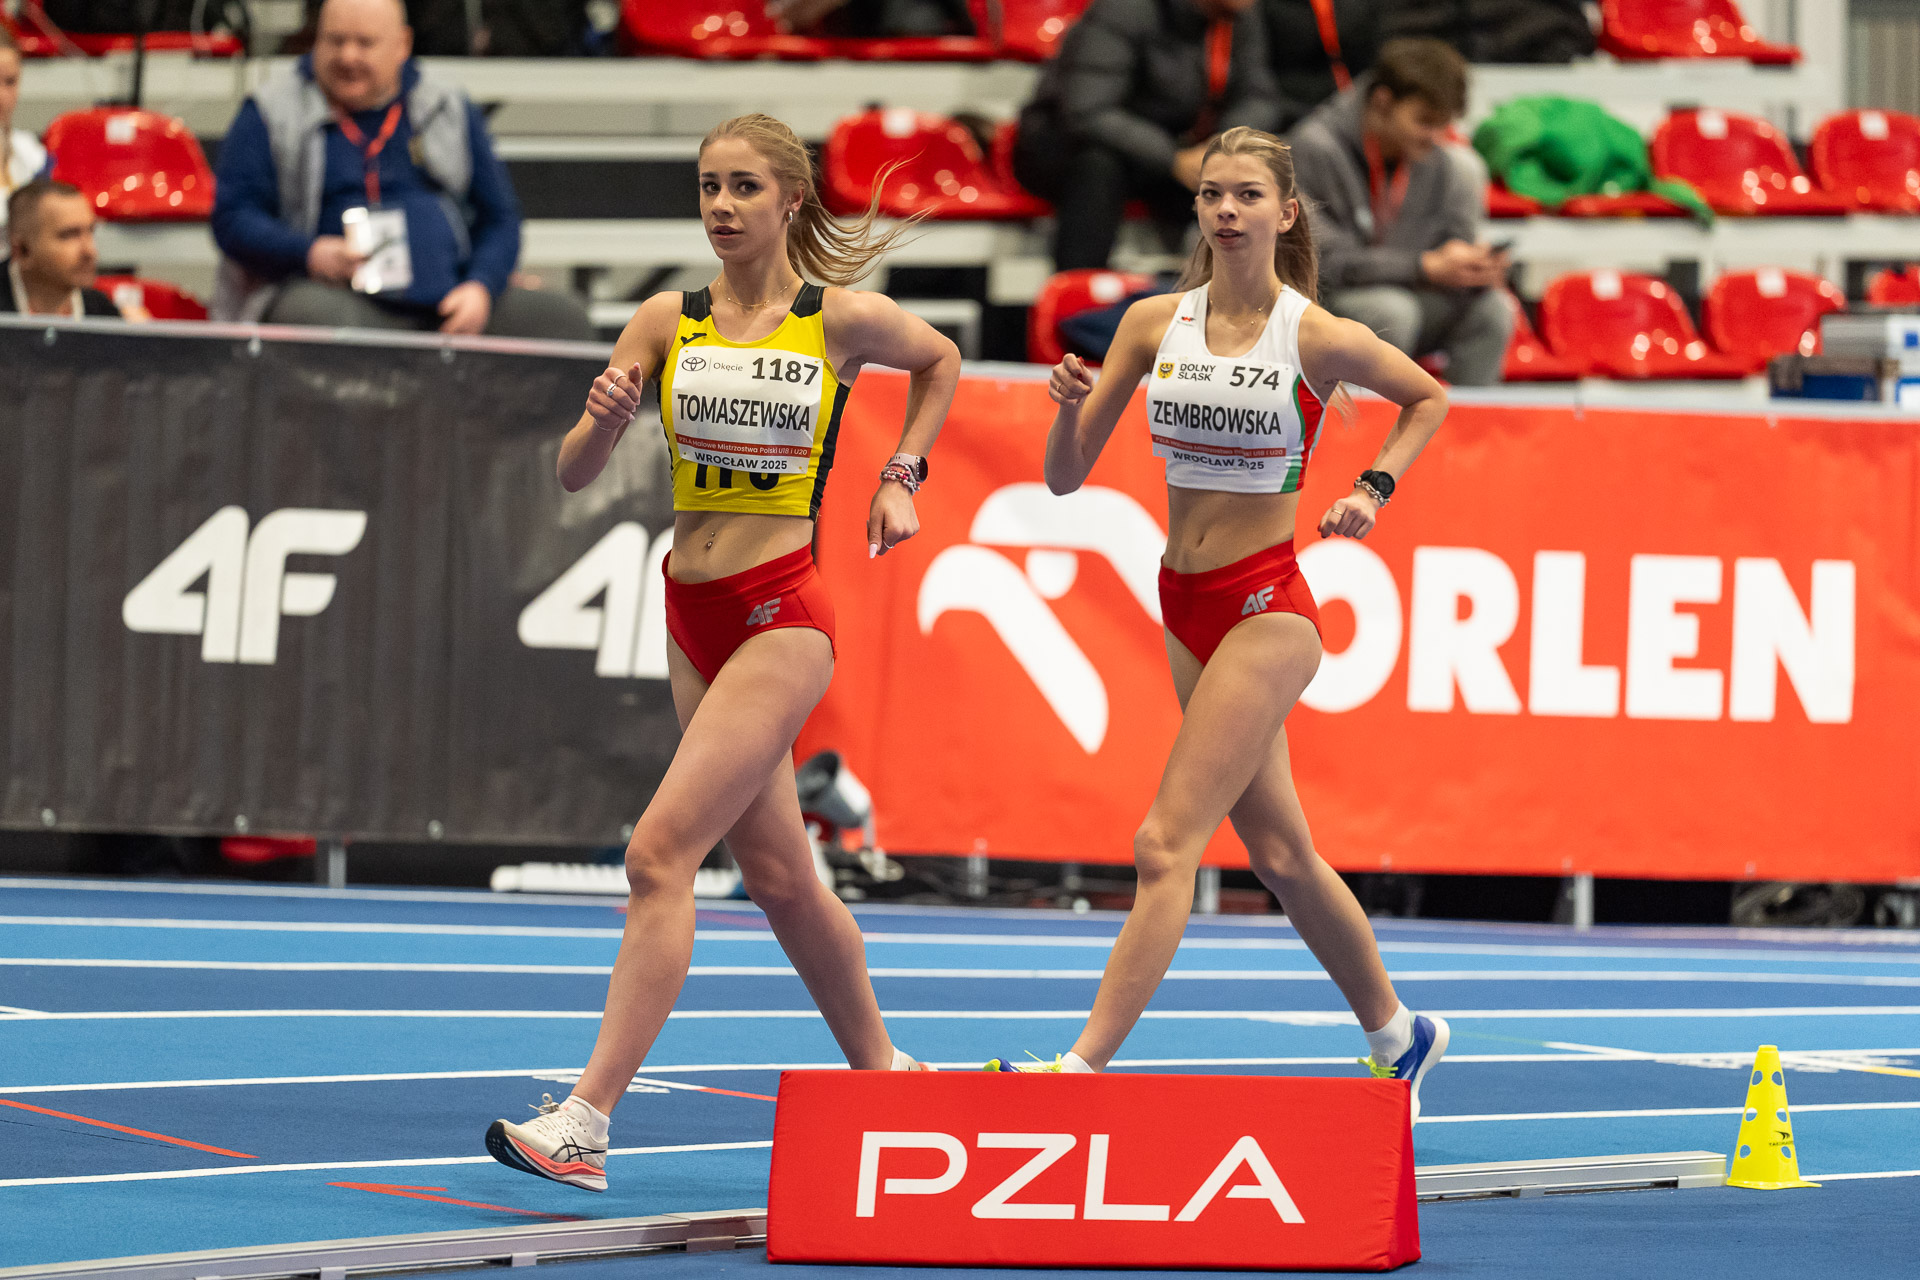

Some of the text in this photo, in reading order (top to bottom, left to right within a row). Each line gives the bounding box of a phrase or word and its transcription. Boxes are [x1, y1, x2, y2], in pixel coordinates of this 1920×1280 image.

[713, 357, 819, 386] Okęcie 1187
[1179, 363, 1280, 391] DOLNY 574
[677, 394, 810, 431] TOMASZEWSKA
[1153, 400, 1281, 435] ZEMBROWSKA
[678, 436, 693, 445] PZLA
[692, 439, 717, 450] Halowe
[717, 442, 758, 453] Mistrzostwa
[794, 448, 808, 456] U20
[694, 451, 788, 470] WROCŁAW 2025
[1172, 450, 1235, 467] WROCŁAW
[122, 505, 367, 664] 4F
[746, 597, 782, 626] 4F
[1241, 585, 1275, 616] 4F
[1297, 538, 1856, 725] ORLEN
[856, 1131, 1306, 1224] PZLA
